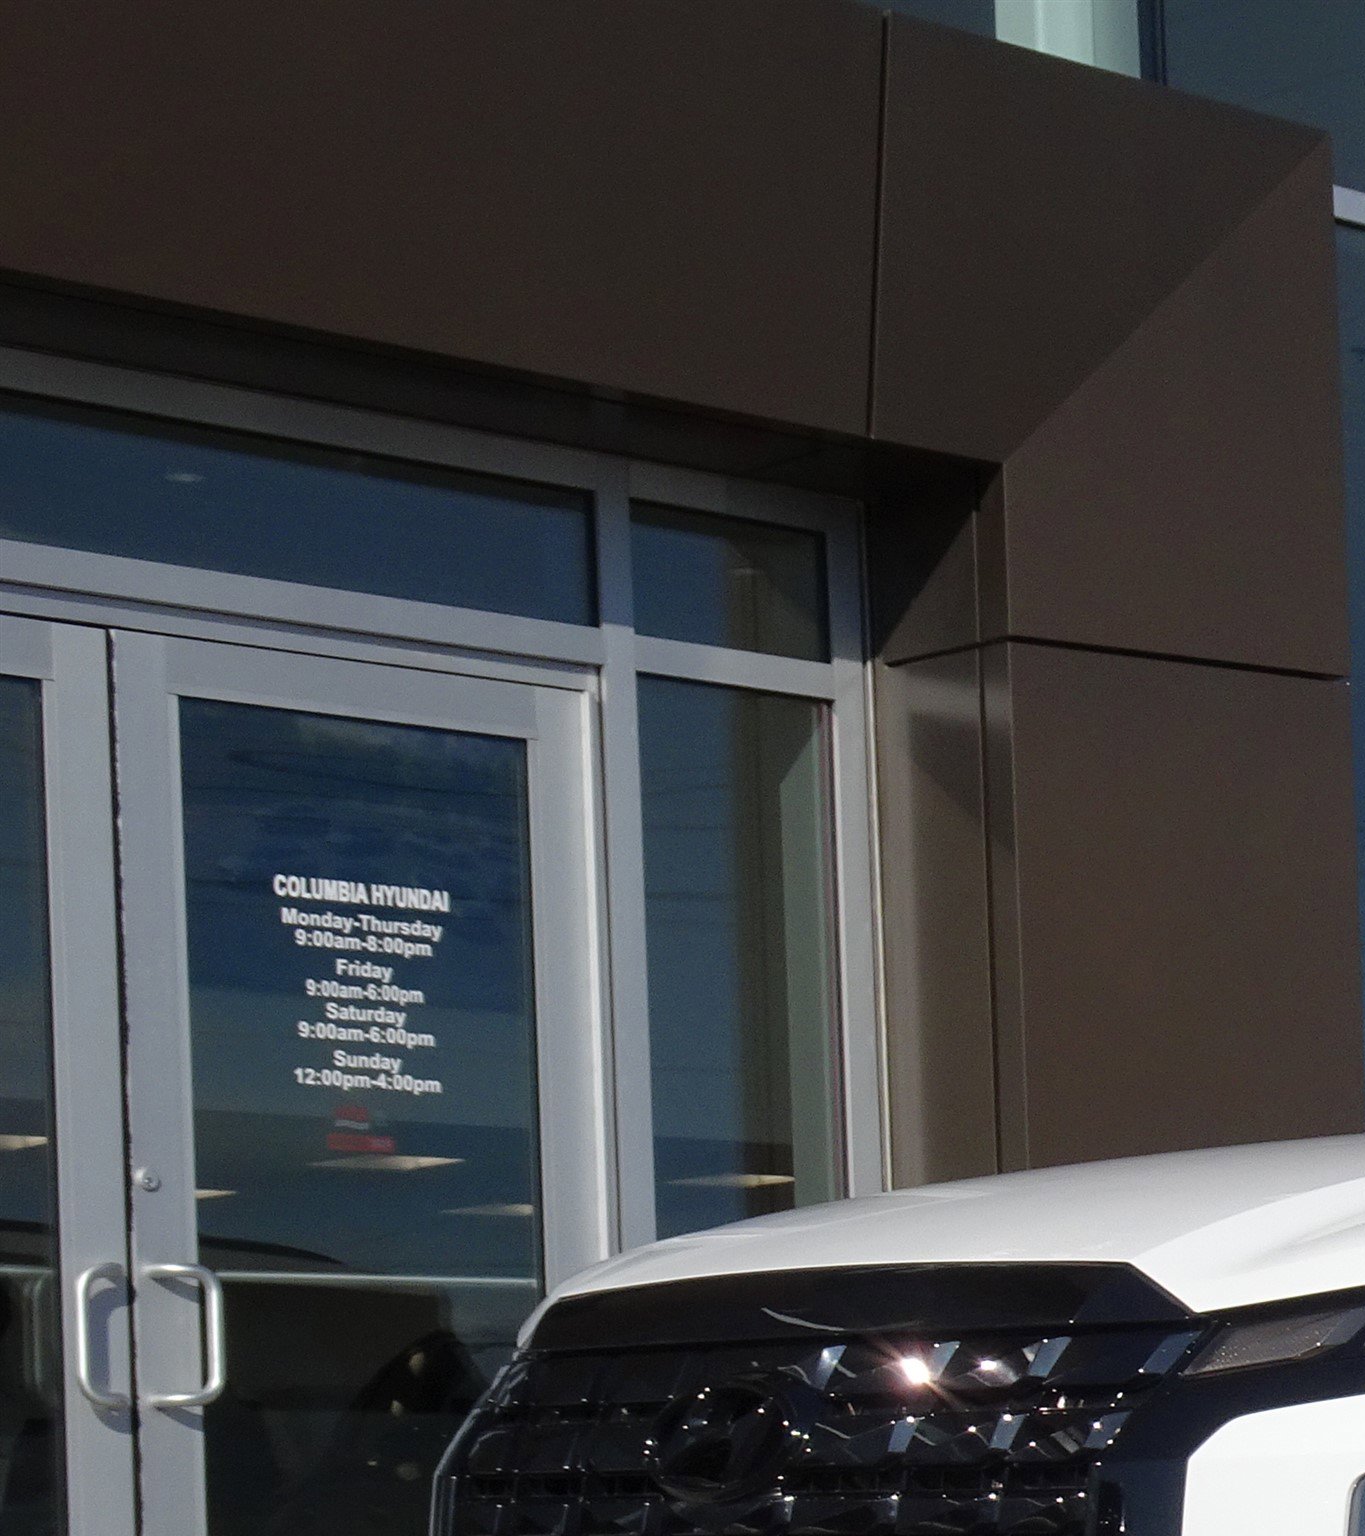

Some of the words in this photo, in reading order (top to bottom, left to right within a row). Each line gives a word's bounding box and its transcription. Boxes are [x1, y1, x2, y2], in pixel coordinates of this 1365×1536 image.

[273, 874, 369, 905] COLUMBIA
[371, 883, 450, 913] HYUNDAI
[281, 907, 443, 942] Monday-Thursday
[295, 929, 433, 959] 9:00am-8:00pm
[335, 958, 394, 983] Friday
[305, 978, 425, 1006] 9:00am-6:00pm
[325, 1002, 408, 1027] Saturday
[297, 1020, 436, 1049] 9:00am-6:00pm
[333, 1050, 403, 1073] Sunday
[294, 1067, 443, 1095] 12:00pm-4:00pm
